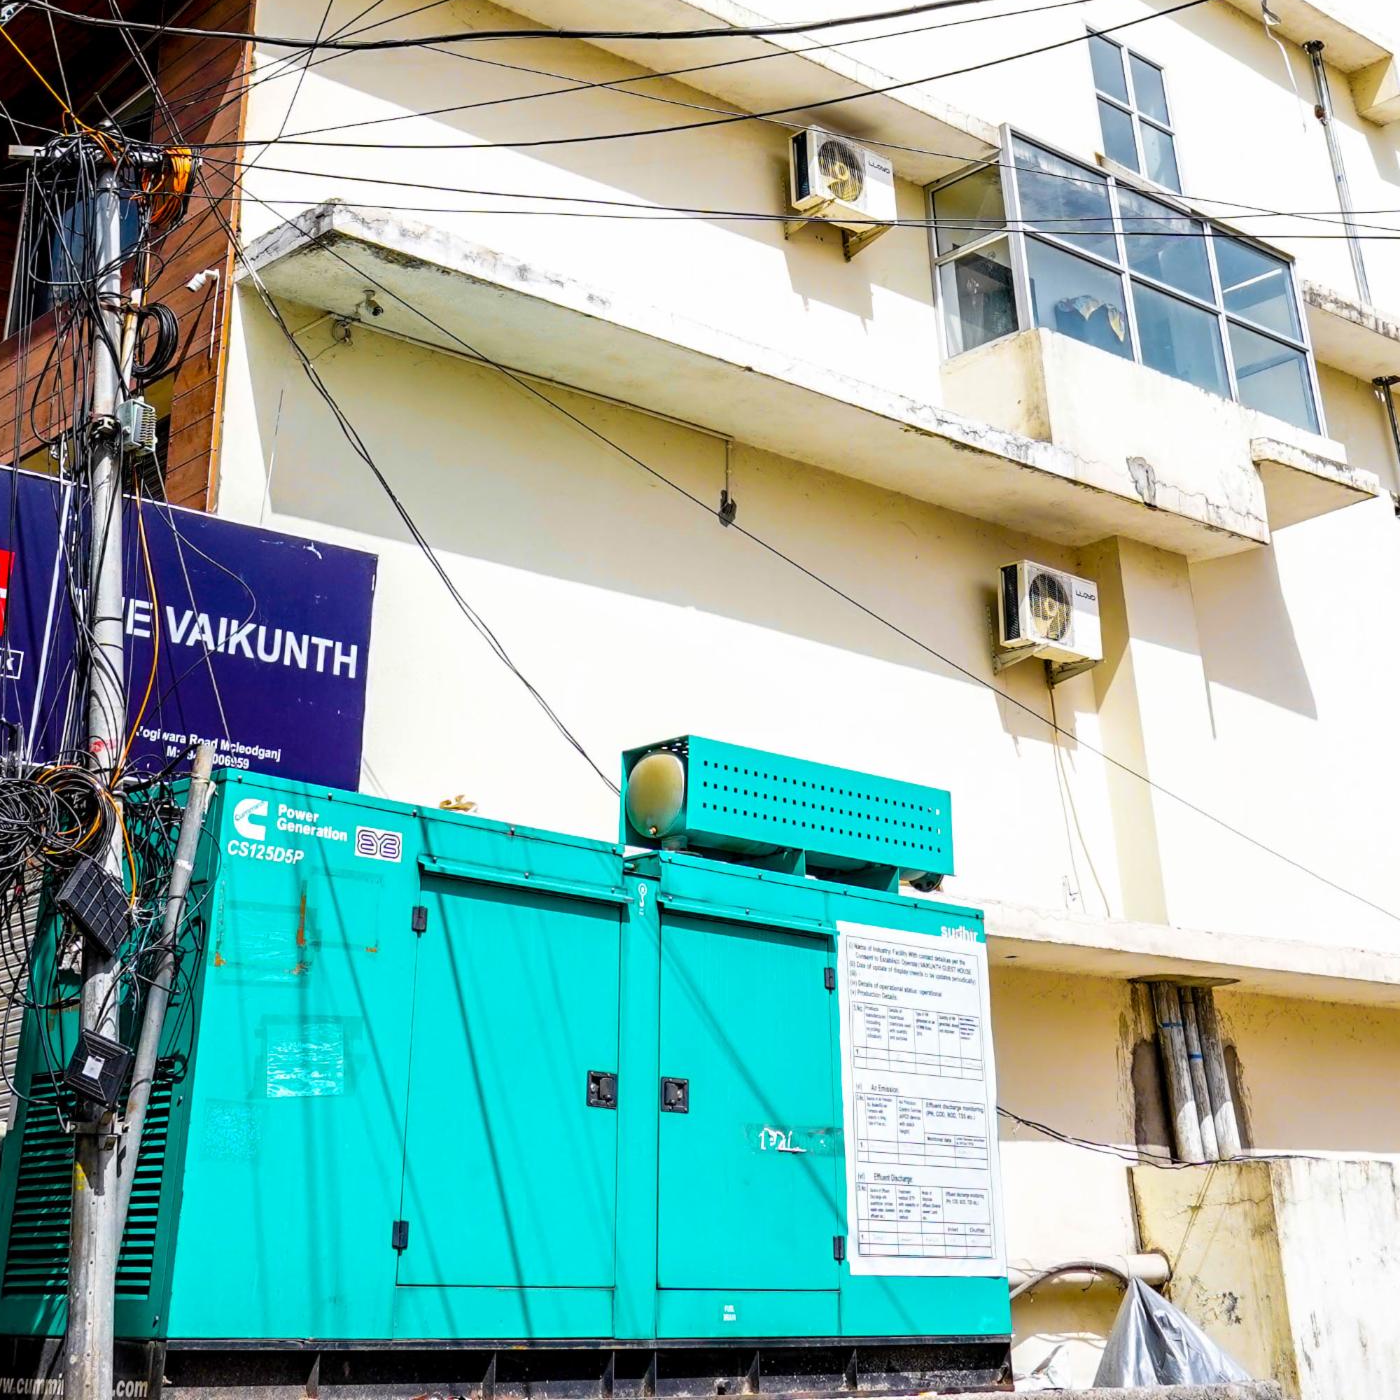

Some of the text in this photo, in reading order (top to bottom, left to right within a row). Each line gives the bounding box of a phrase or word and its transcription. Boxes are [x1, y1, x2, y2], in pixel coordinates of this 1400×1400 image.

[165, 605, 358, 679] VAIKUNTH
[166, 745, 180, 758] M:
[189, 733, 218, 749] Road
[220, 739, 281, 763] Mcleodganj
[277, 803, 320, 823] Power
[276, 817, 348, 842] Generation
[227, 839, 305, 865] CS125D5P
